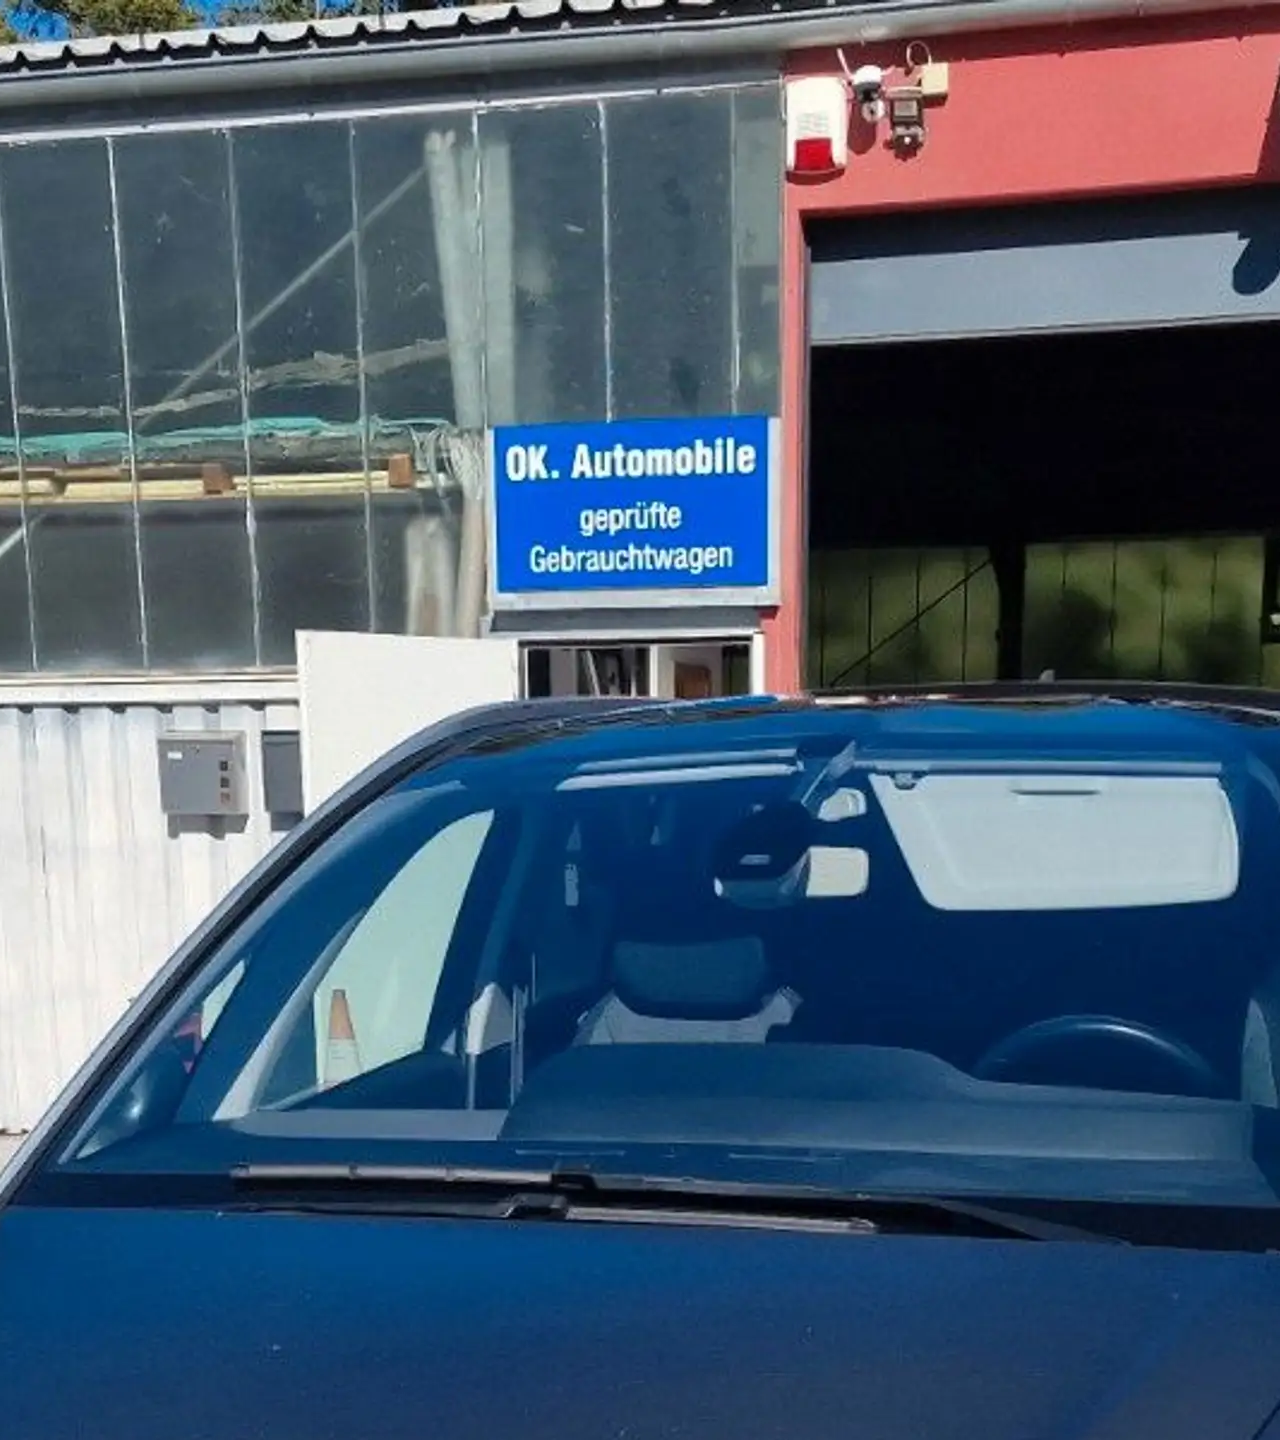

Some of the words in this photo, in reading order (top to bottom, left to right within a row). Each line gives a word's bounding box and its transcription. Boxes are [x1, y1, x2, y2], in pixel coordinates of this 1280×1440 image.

[507, 446, 558, 480] OK.
[572, 438, 755, 478] Automobile
[581, 502, 681, 536] geprüfte
[531, 544, 732, 574] Gebrauchtwagen
